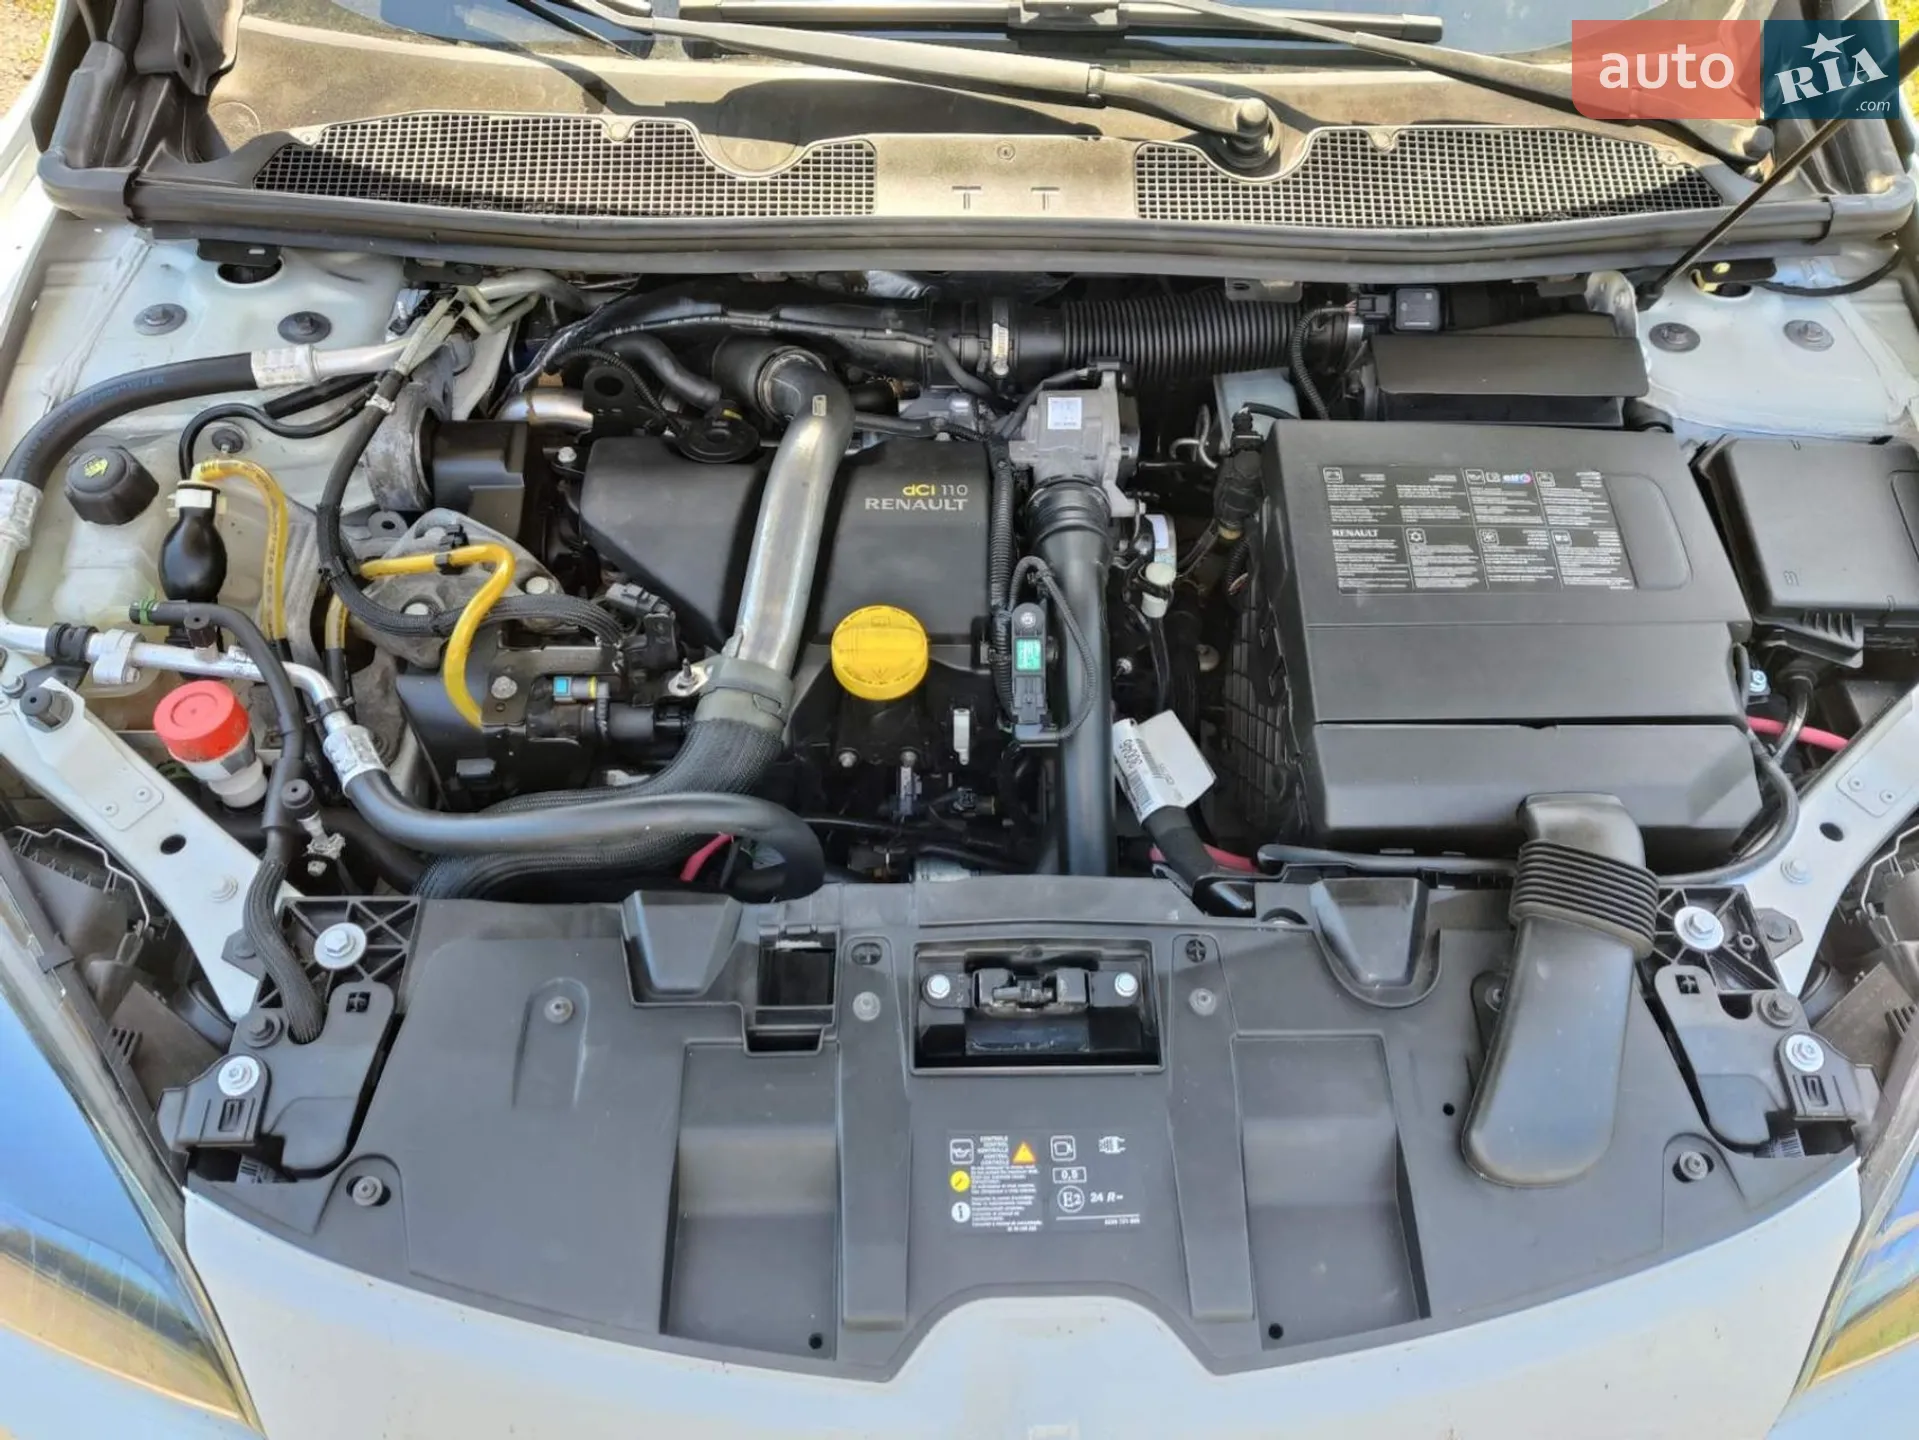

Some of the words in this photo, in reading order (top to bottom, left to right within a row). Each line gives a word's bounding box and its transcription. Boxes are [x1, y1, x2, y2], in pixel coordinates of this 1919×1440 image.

[941, 484, 968, 496] 110
[864, 498, 968, 511] RENAULT
[1331, 529, 1378, 537] RENAULT
